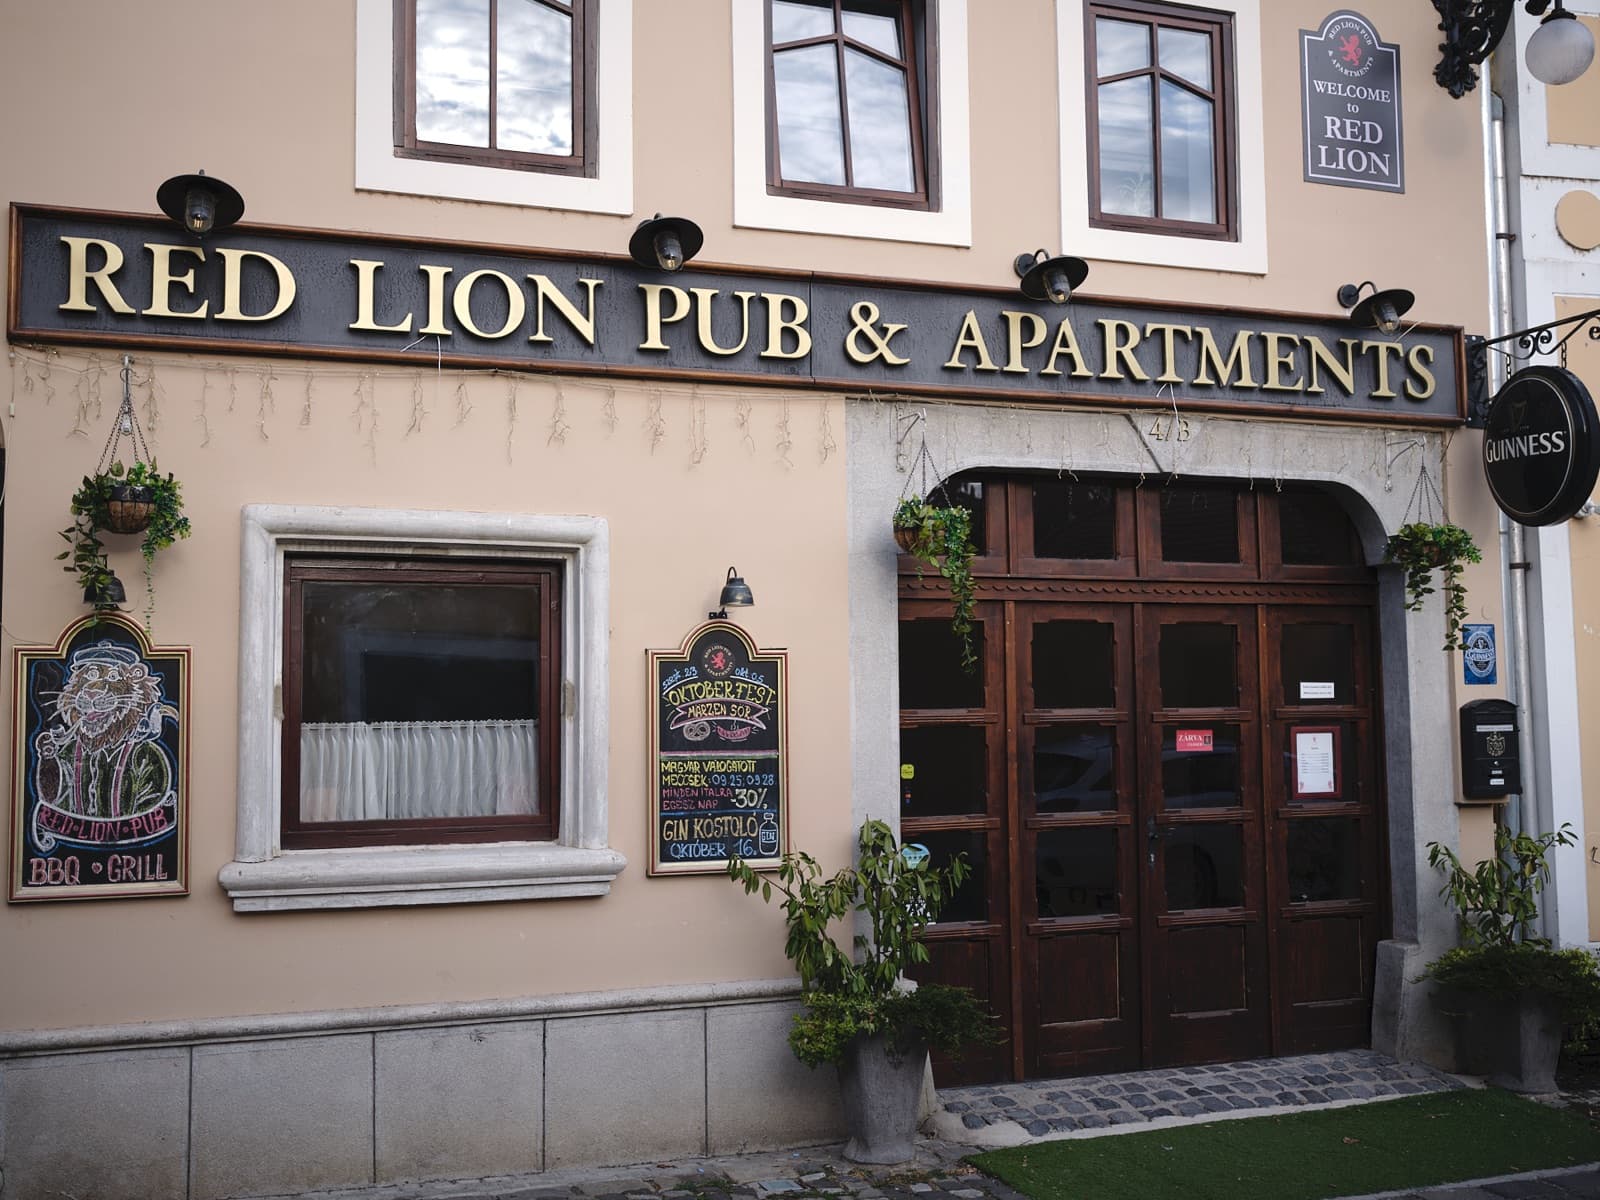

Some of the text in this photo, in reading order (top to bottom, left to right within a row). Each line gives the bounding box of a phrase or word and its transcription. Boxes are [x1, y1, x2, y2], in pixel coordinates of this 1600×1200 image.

[1313, 80, 1391, 103] WELCOME
[1347, 102, 1359, 113] to
[1324, 115, 1383, 144] RED
[1318, 144, 1390, 176] LION
[58, 236, 1436, 399] RED LION PUB & APARTMENTS
[1486, 431, 1565, 463] GUINNESS
[669, 681, 776, 705] OKTOBERFEST
[661, 760, 701, 773] MAGYAR
[698, 799, 719, 809] NAP
[701, 788, 733, 798] ITALRA
[730, 788, 768, 809] -30%
[38, 805, 168, 841] RED LION PUB
[663, 818, 689, 841] GIN
[761, 831, 775, 841] GIN
[670, 839, 727, 859] OKTÓBER
[28, 853, 168, 885] BBQ GRILL
